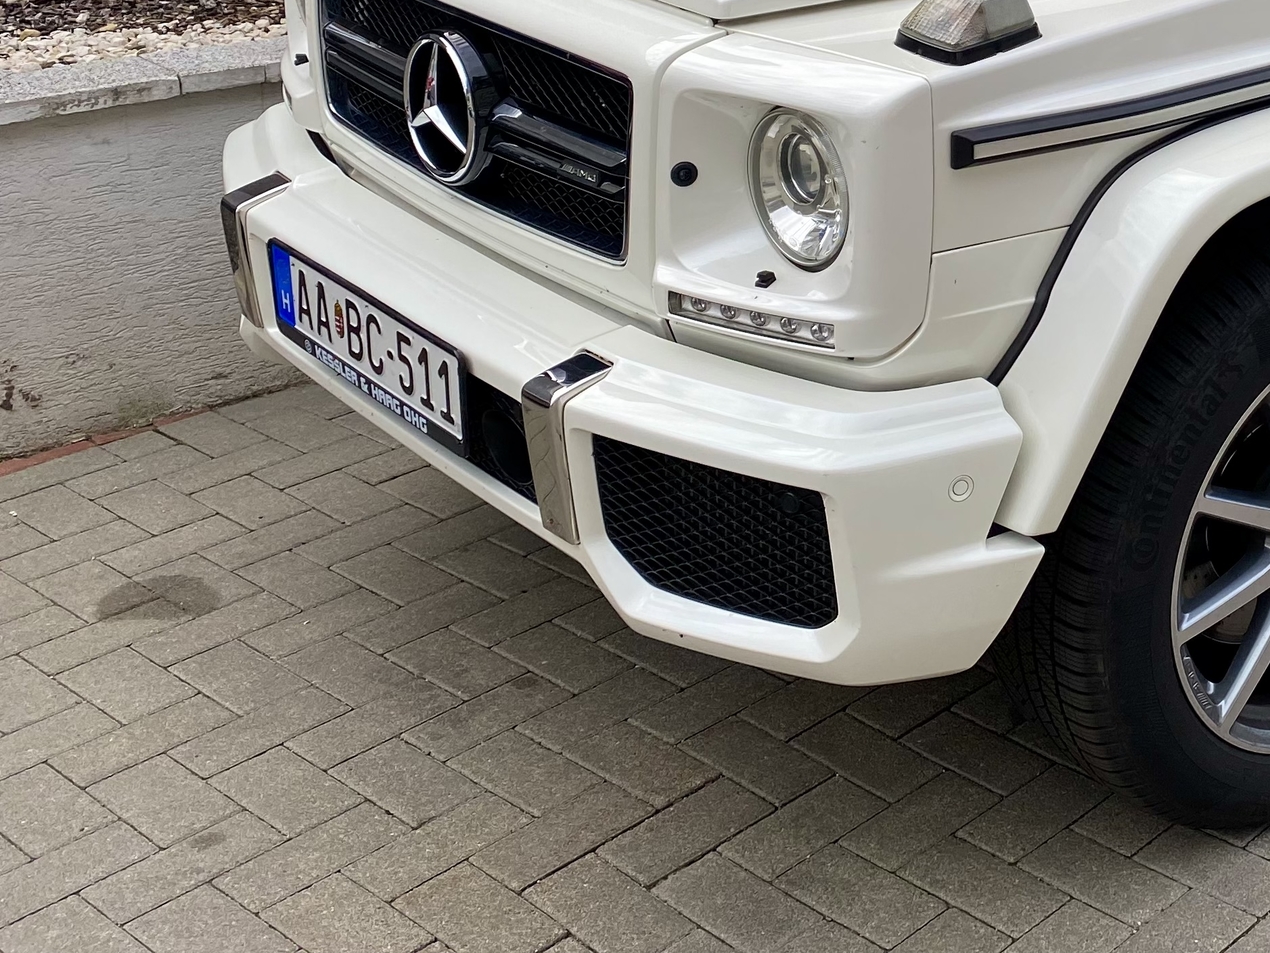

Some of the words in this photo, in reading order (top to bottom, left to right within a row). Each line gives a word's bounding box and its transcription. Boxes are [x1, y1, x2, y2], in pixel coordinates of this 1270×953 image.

[281, 289, 291, 313] H
[314, 344, 361, 385] KESSLER
[360, 378, 370, 396] &
[370, 382, 401, 416] HAAG
[403, 405, 428, 434] OHG
